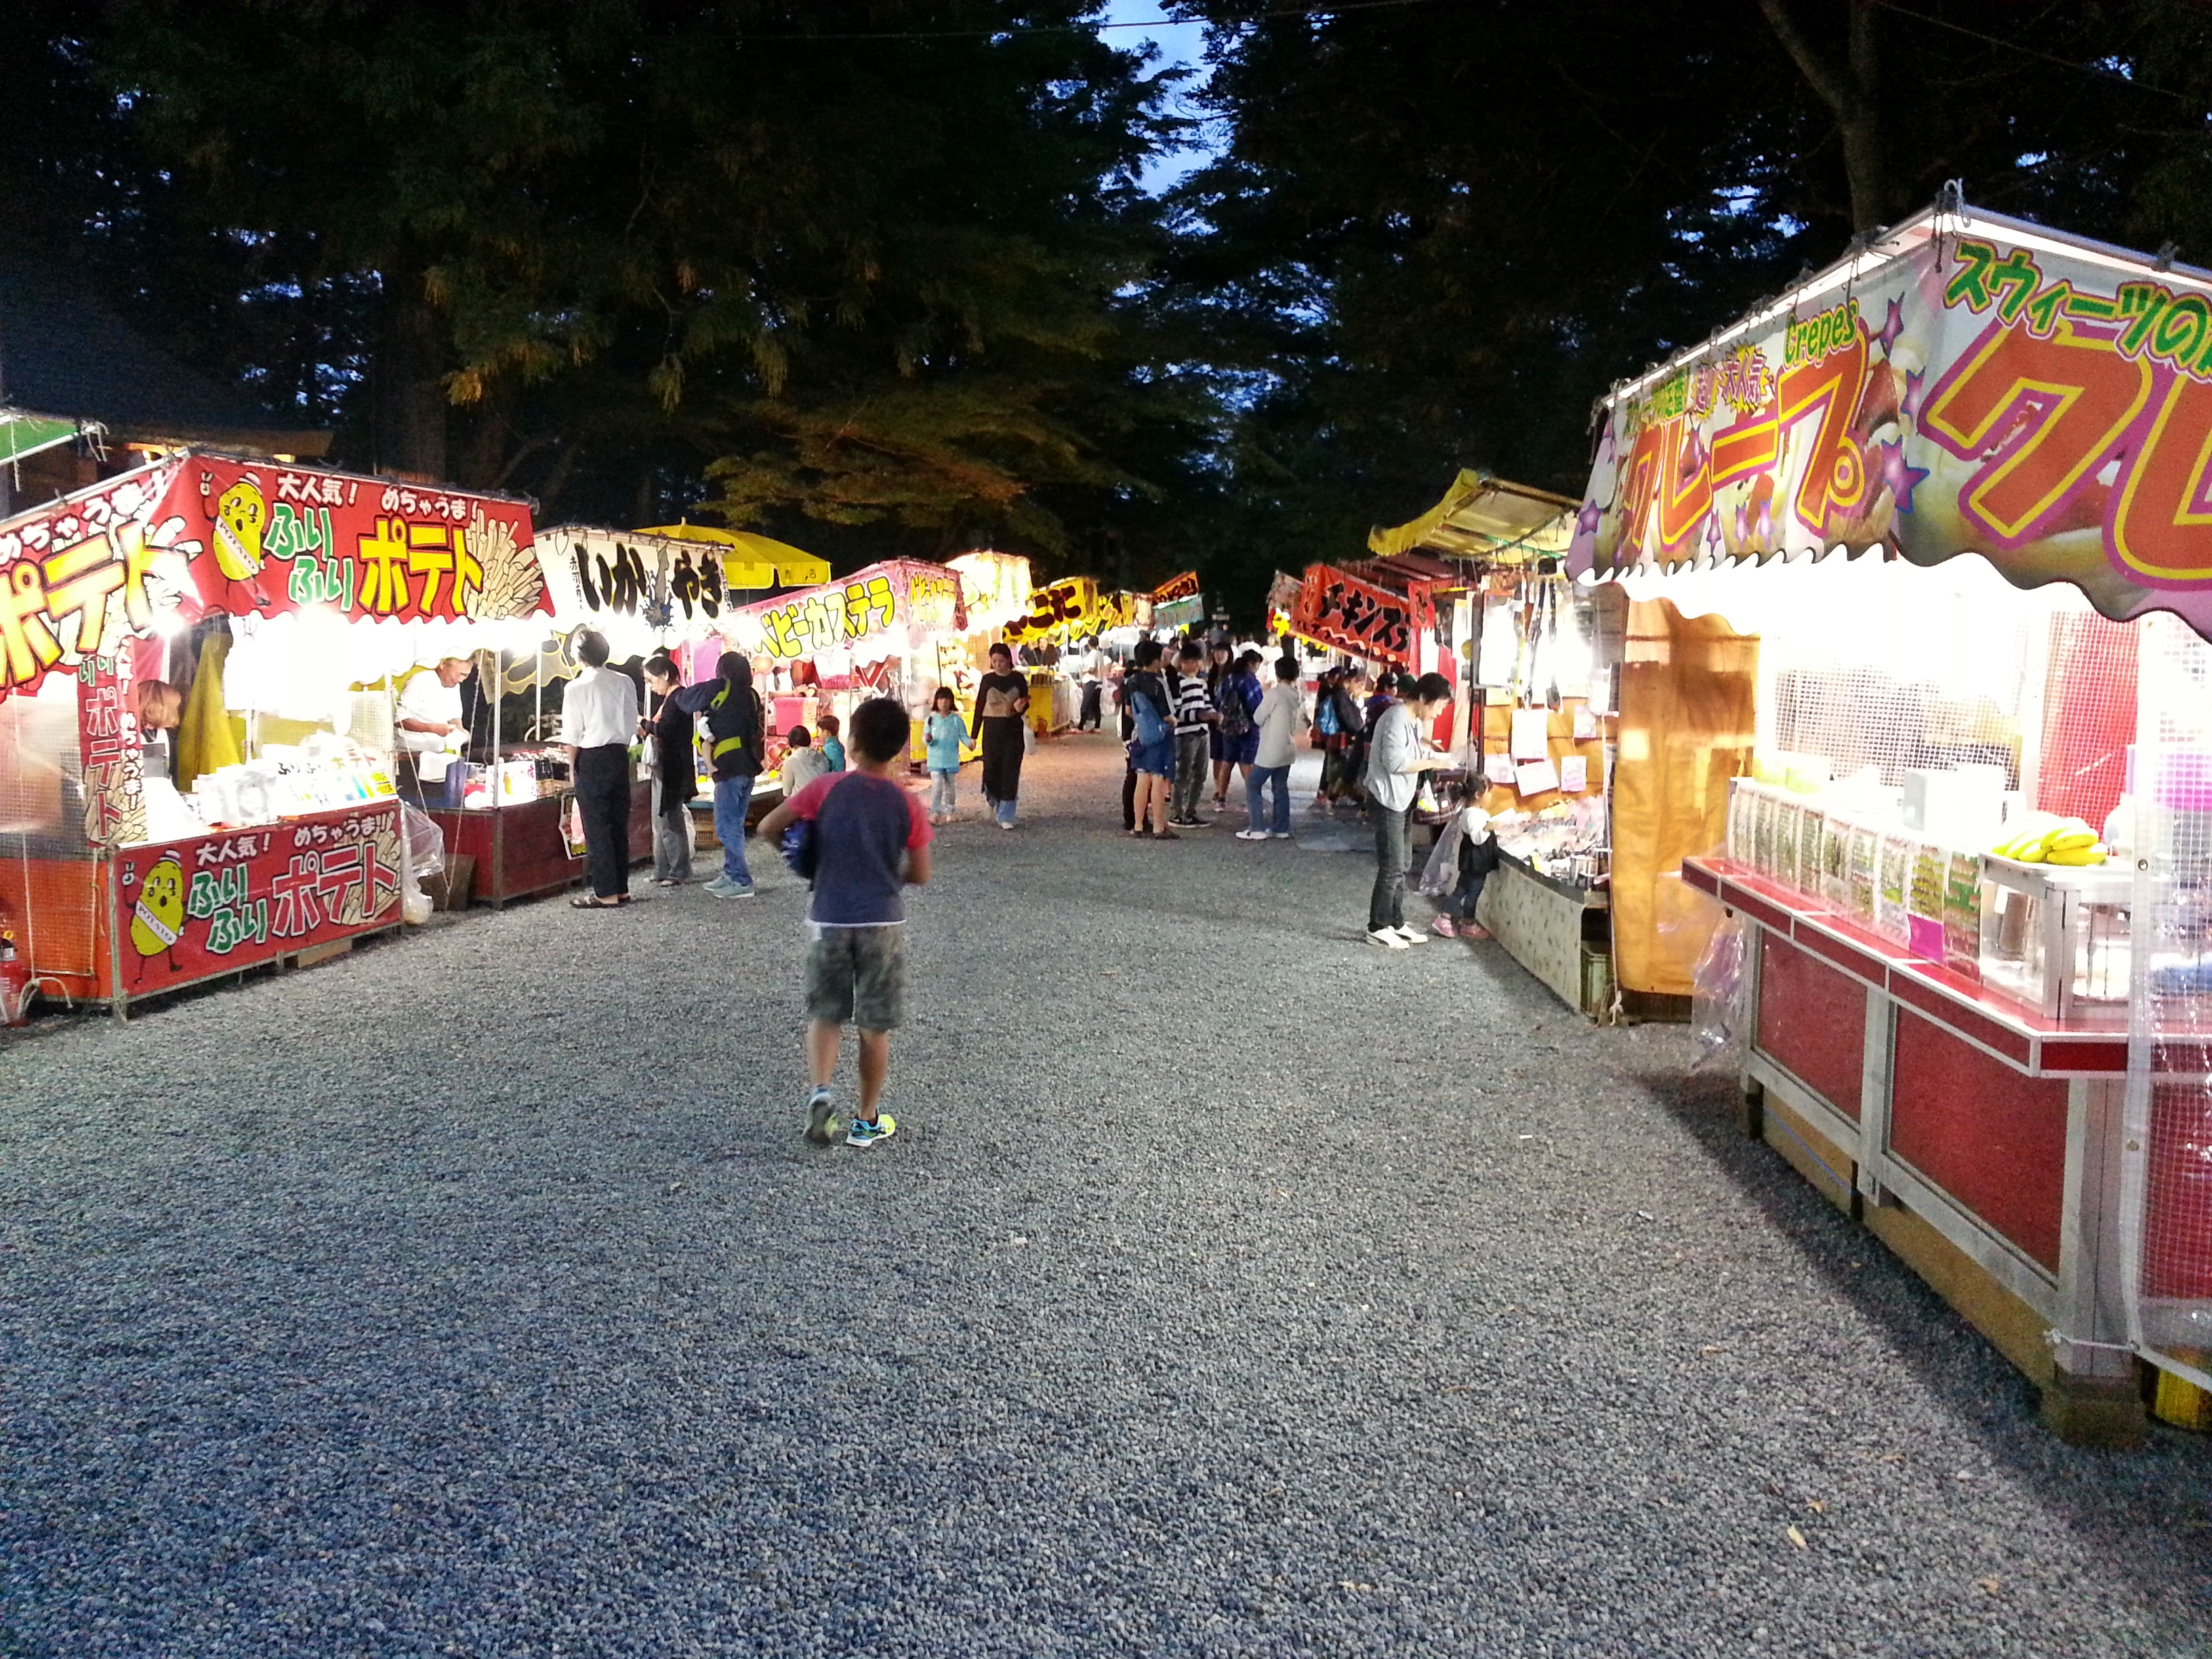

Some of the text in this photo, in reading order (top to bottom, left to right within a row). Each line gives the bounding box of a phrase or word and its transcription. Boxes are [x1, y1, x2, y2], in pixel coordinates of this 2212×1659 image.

[1784, 299, 1858, 366] Crepes
[1944, 239, 2212, 373] スウィーツの
[1623, 327, 1865, 552] クレープ
[277, 473, 478, 520] 大人気! めちゃうま!
[358, 518, 483, 614] ポテト
[753, 575, 895, 658] ベビーカステラ
[115, 638, 134, 695] 人気!
[85, 687, 122, 839] ポテト
[195, 833, 270, 866] 大人気!
[272, 842, 397, 937] ポテト
[138, 905, 173, 941] POTATO
